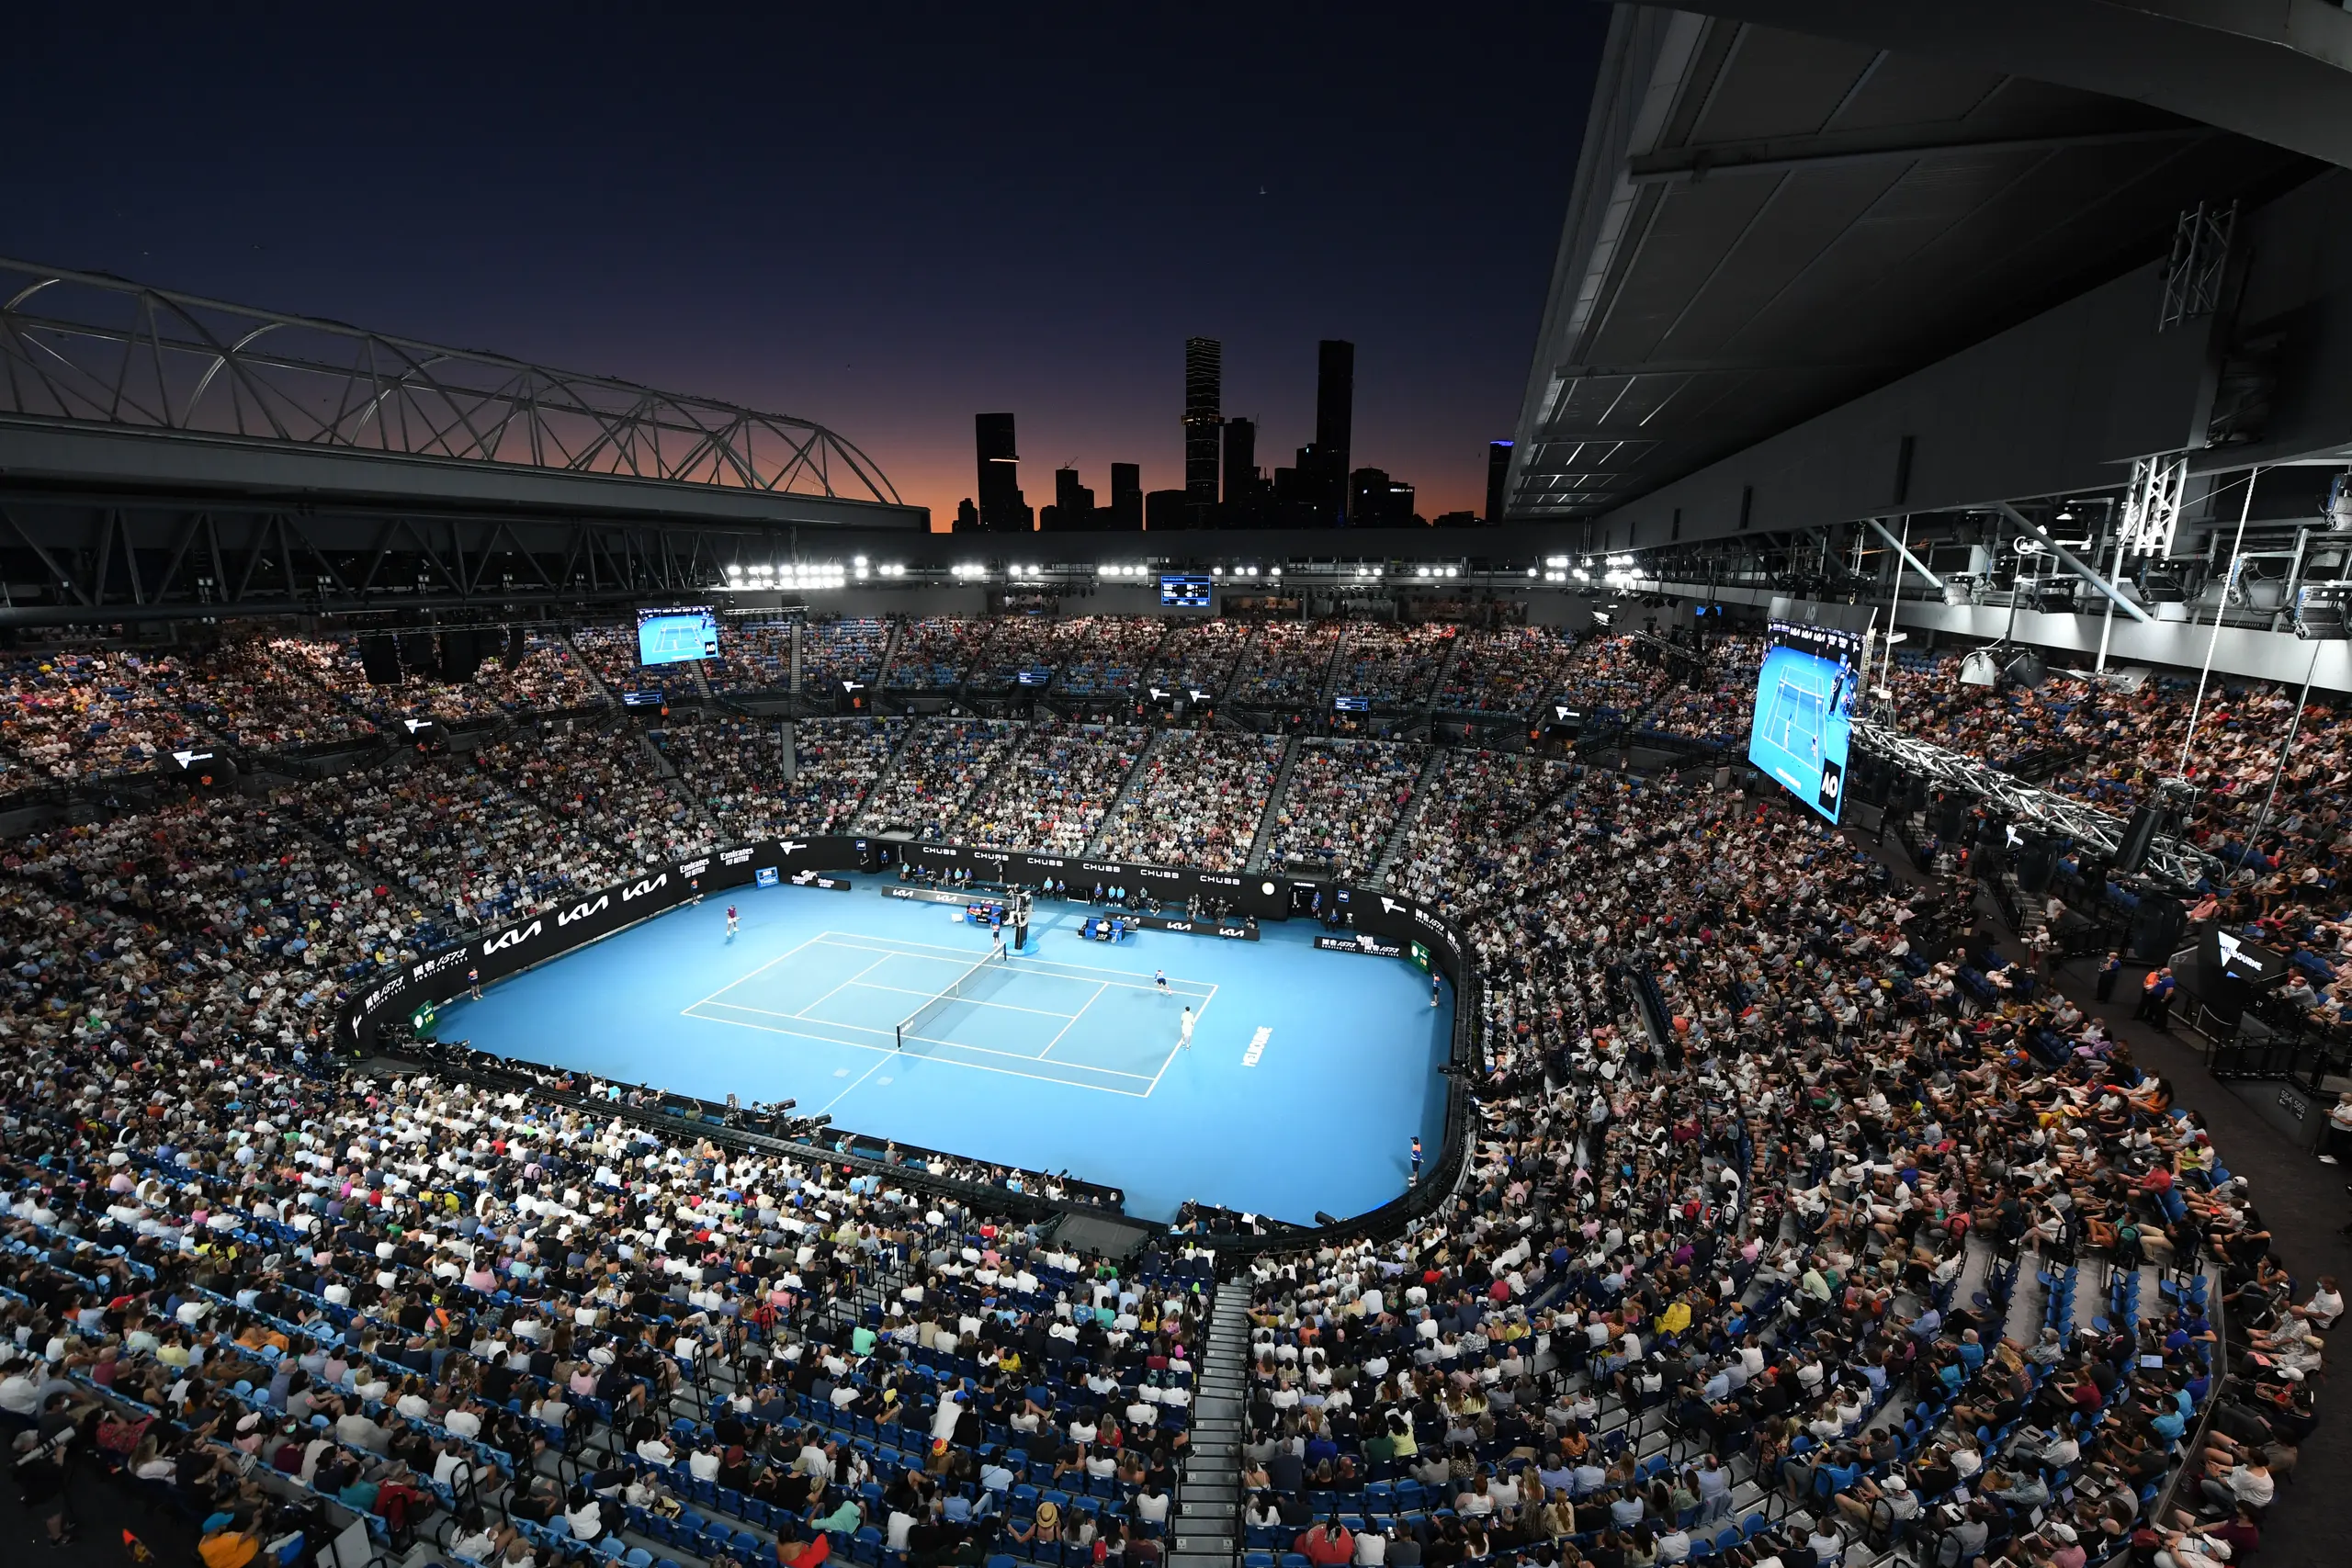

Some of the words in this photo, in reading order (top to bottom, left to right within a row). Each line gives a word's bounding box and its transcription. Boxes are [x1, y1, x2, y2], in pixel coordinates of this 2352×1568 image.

[1821, 775, 1838, 797] AO
[720, 847, 753, 861] Emirates
[922, 847, 957, 856] CHUBB
[974, 852, 1009, 862] CHUBB
[680, 858, 709, 874] Emirates
[1027, 858, 1064, 867] CHUBB
[1082, 863, 1121, 873] CHUBB
[1140, 869, 1180, 878] CHUBB
[1200, 874, 1240, 886] CHUBB
[622, 873, 667, 902] KIA
[893, 889, 913, 897] KIA
[935, 894, 957, 902] KIA
[558, 895, 608, 926] KIA
[1167, 922, 1191, 931] KIA
[483, 920, 542, 955] KIA
[1219, 928, 1244, 937] KIA
[1240, 1025, 1273, 1067] MELBOURNE
[2280, 1089, 2293, 1104] 554
[2293, 1100, 2306, 1113] 555
